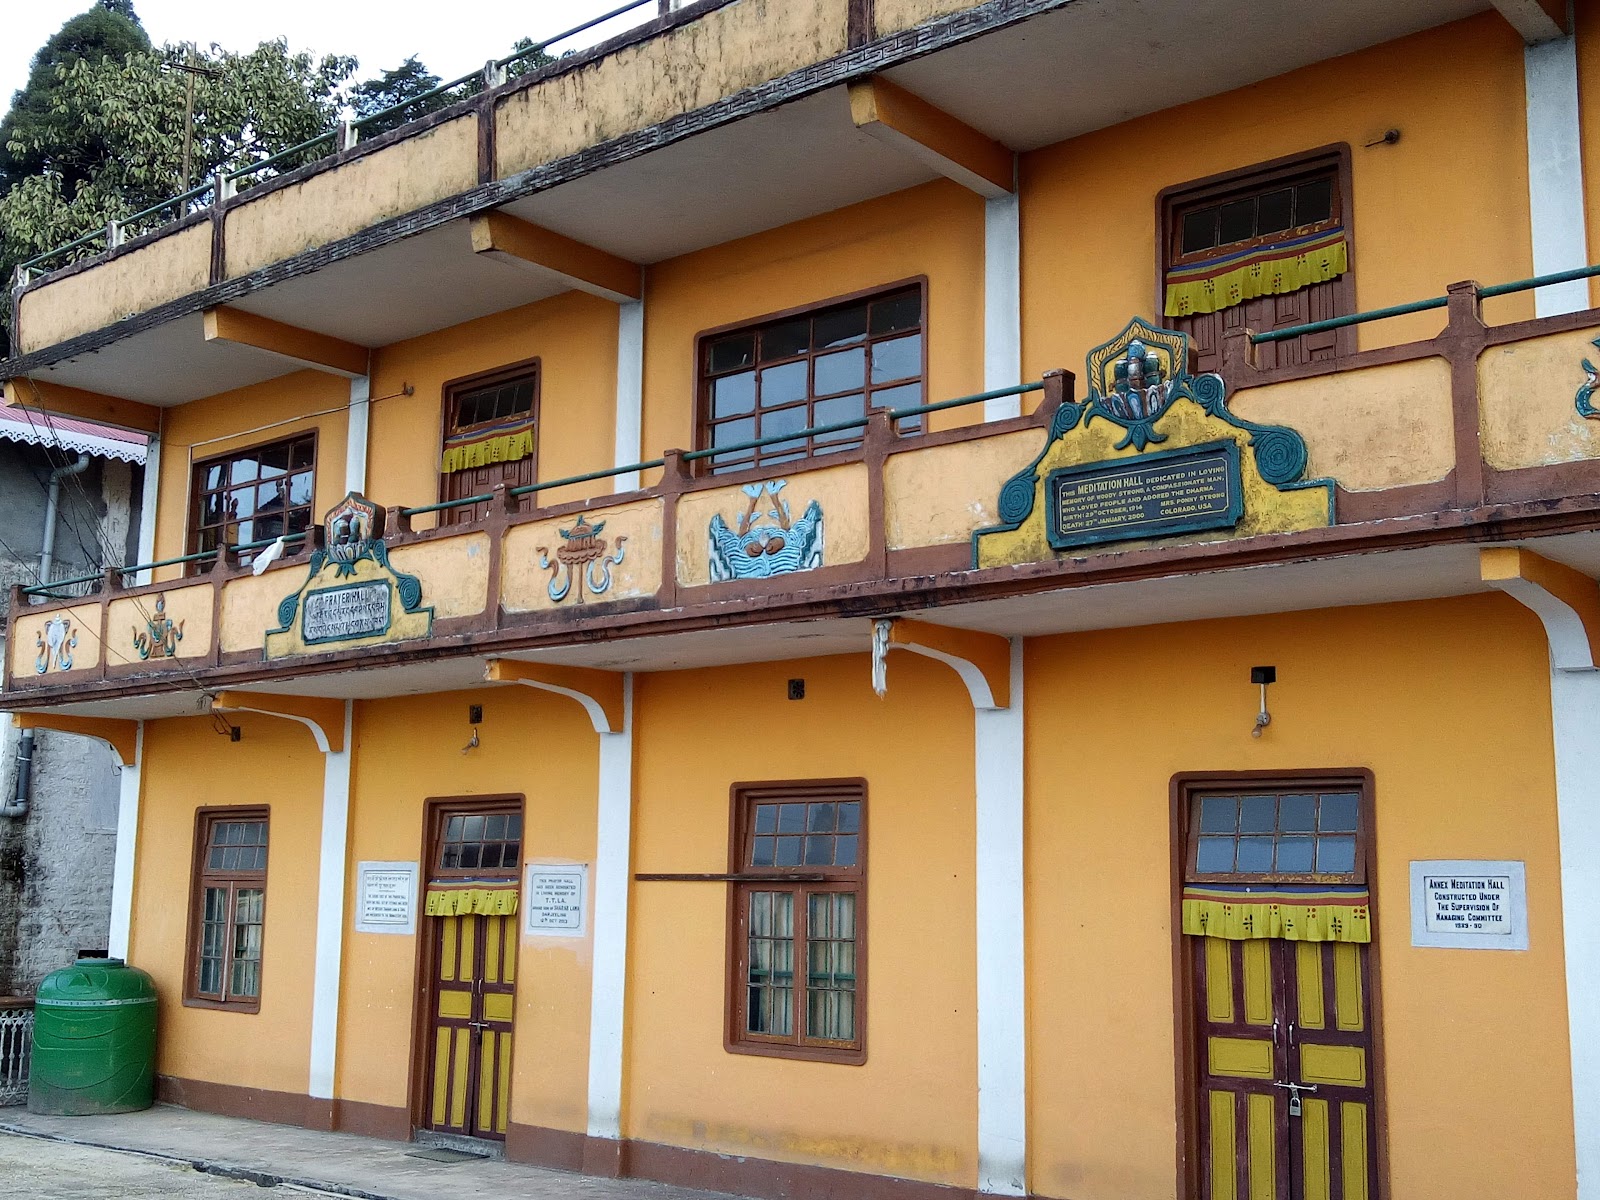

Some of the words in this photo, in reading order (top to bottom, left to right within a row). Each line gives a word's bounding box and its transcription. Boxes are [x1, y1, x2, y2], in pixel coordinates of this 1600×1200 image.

[1078, 479, 1122, 494] MEDITATION
[1124, 476, 1143, 487] HALL
[1146, 473, 1185, 484] DEDICATED
[1199, 466, 1224, 475] LOVING
[1062, 497, 1086, 505] MEMORY
[1152, 478, 1204, 491] COMPASSIONATE
[1100, 499, 1126, 507] PEOPLE
[1143, 492, 1169, 501] ADORED
[326, 592, 350, 605] PRAYER
[352, 589, 369, 602] HALL
[1451, 879, 1485, 889] MEDITATION
[1488, 879, 1504, 889] HALL
[1468, 913, 1502, 921] COMMITTEE
